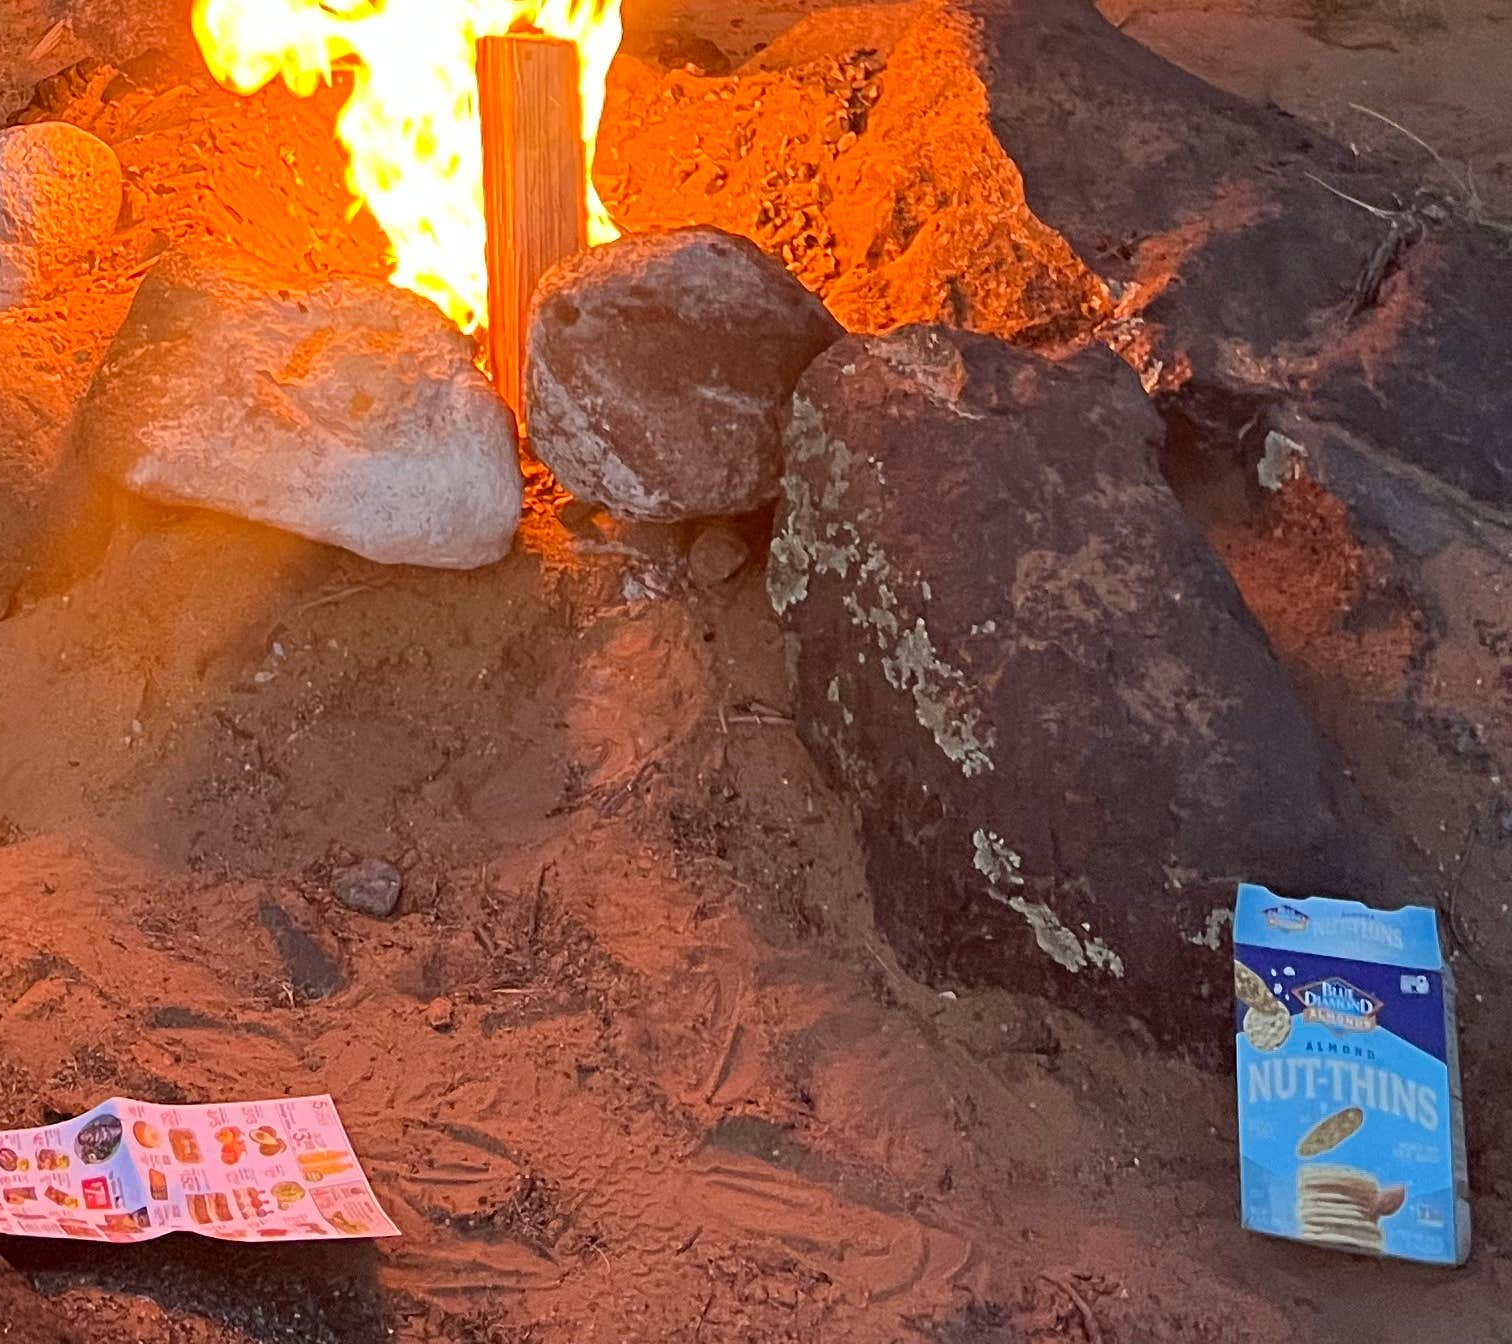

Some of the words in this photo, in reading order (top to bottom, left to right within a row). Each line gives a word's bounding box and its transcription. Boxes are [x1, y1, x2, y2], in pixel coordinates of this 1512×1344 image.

[1305, 991, 1373, 1014] DIAMOND
[1305, 1041, 1376, 1060] ALMOND
[1247, 1056, 1439, 1132] NUT-THINS
